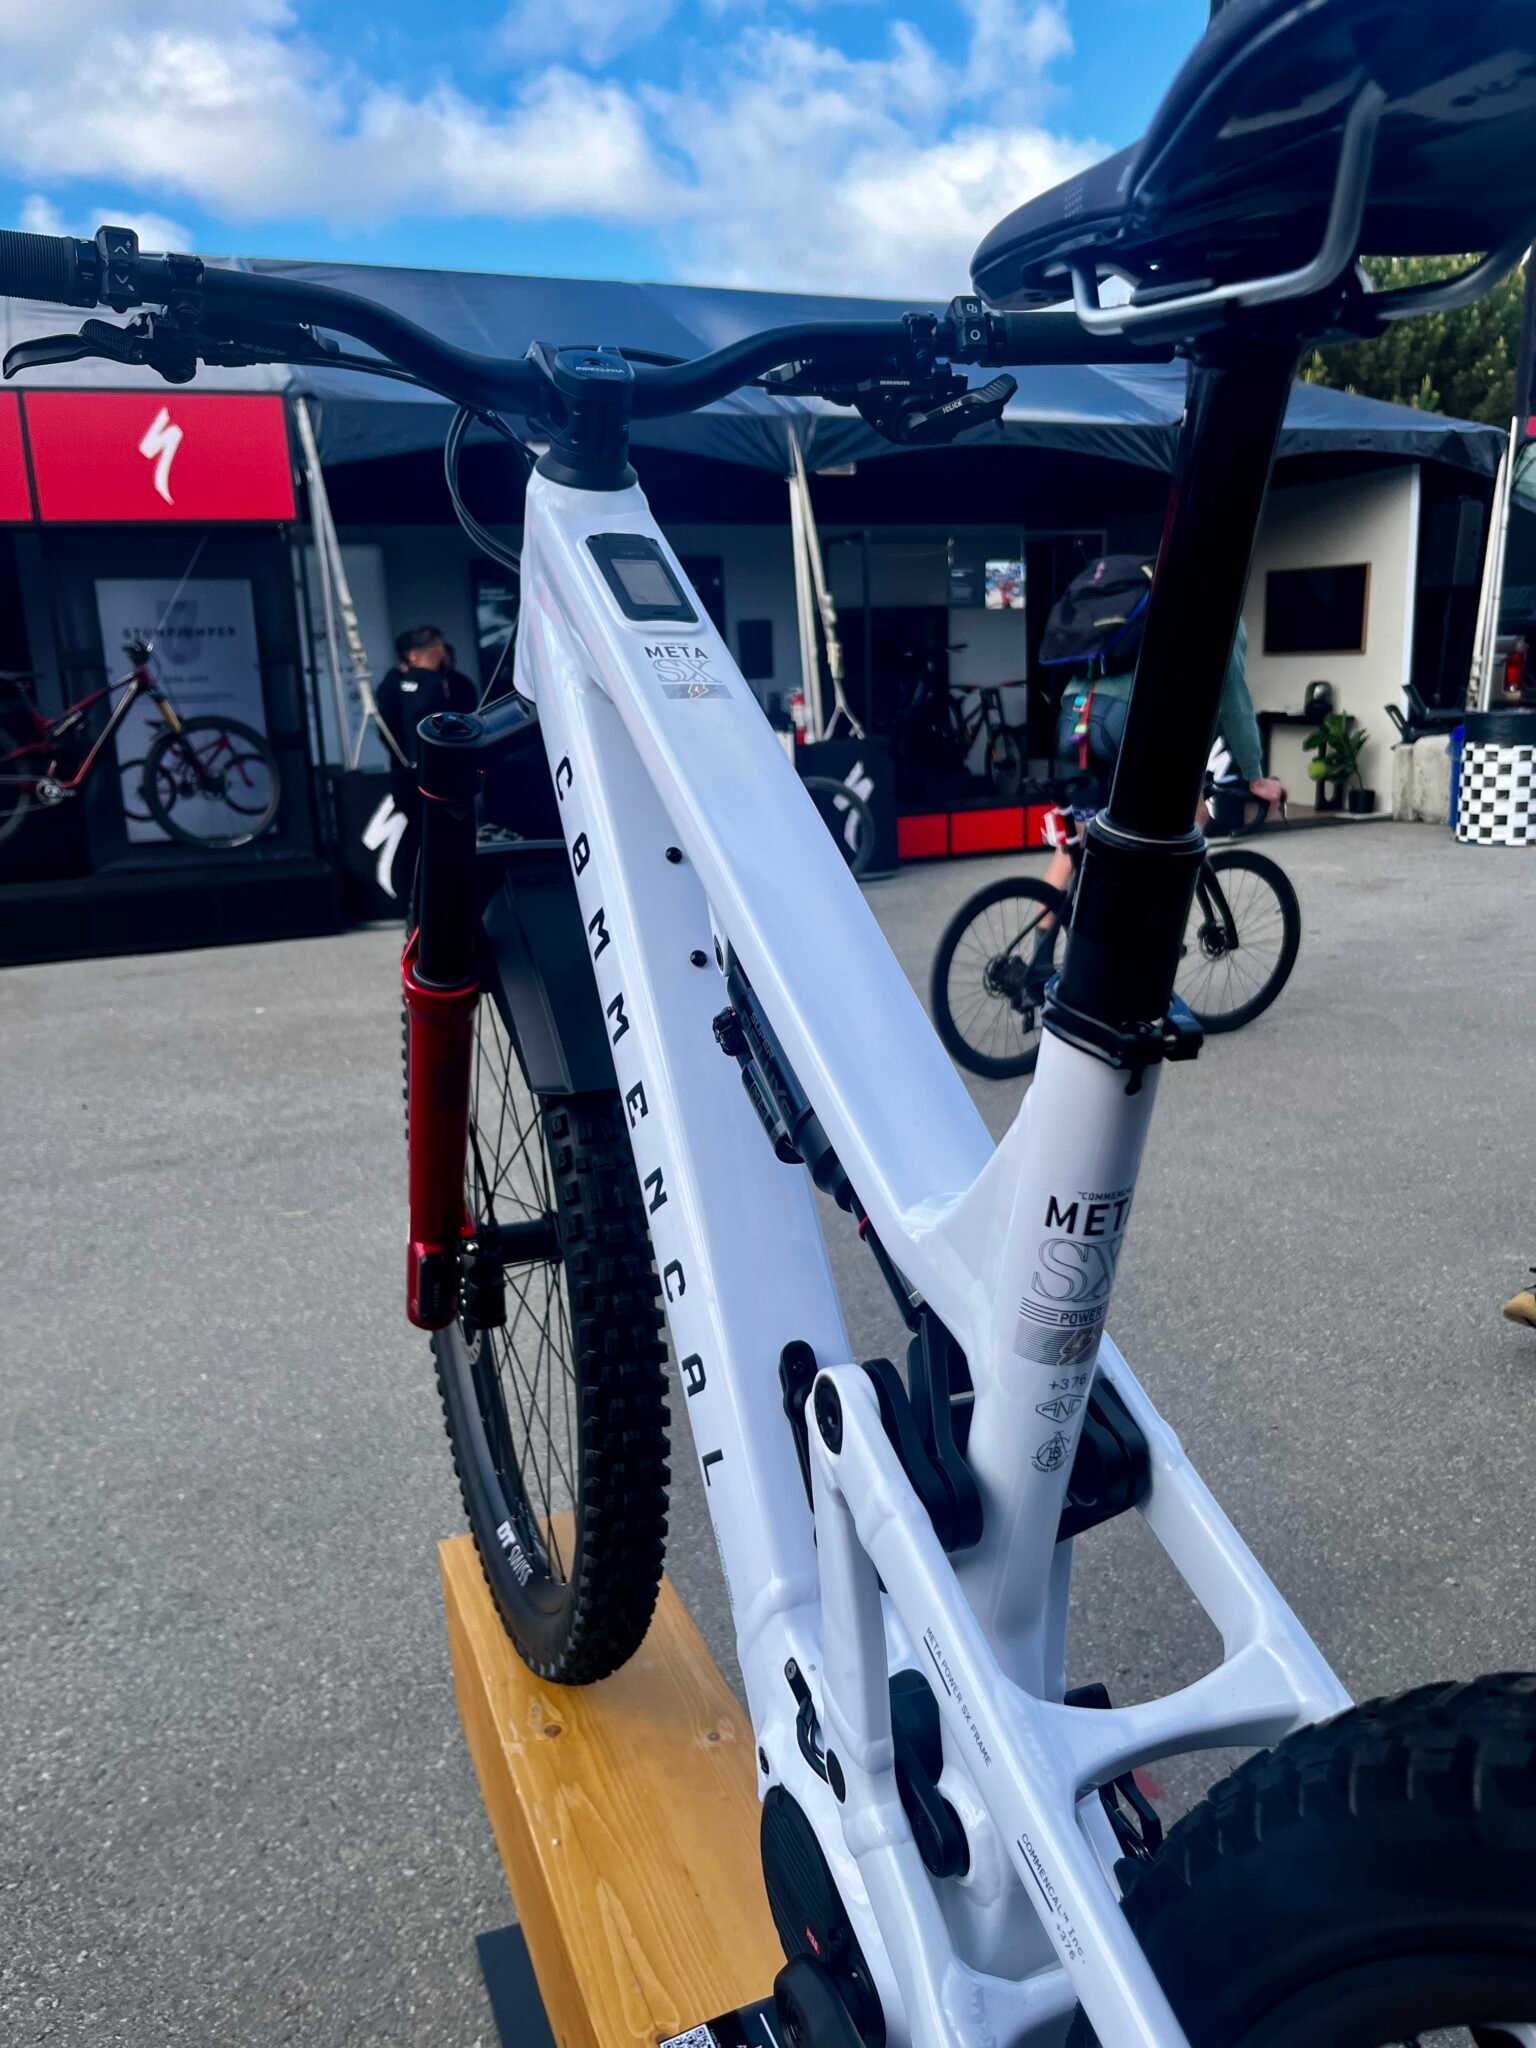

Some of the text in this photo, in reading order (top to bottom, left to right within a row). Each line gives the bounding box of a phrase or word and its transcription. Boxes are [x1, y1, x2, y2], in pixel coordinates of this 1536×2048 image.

[644, 646, 709, 659] META
[652, 658, 722, 683] SX
[750, 1011, 775, 1059] SUPER
[1044, 1195, 1132, 1236] MET
[1048, 1373, 1087, 1391] +376
[496, 1520, 517, 1549] DT
[925, 1627, 992, 1768] META POWER SX FRAME
[1056, 1922, 1076, 1961] +376
